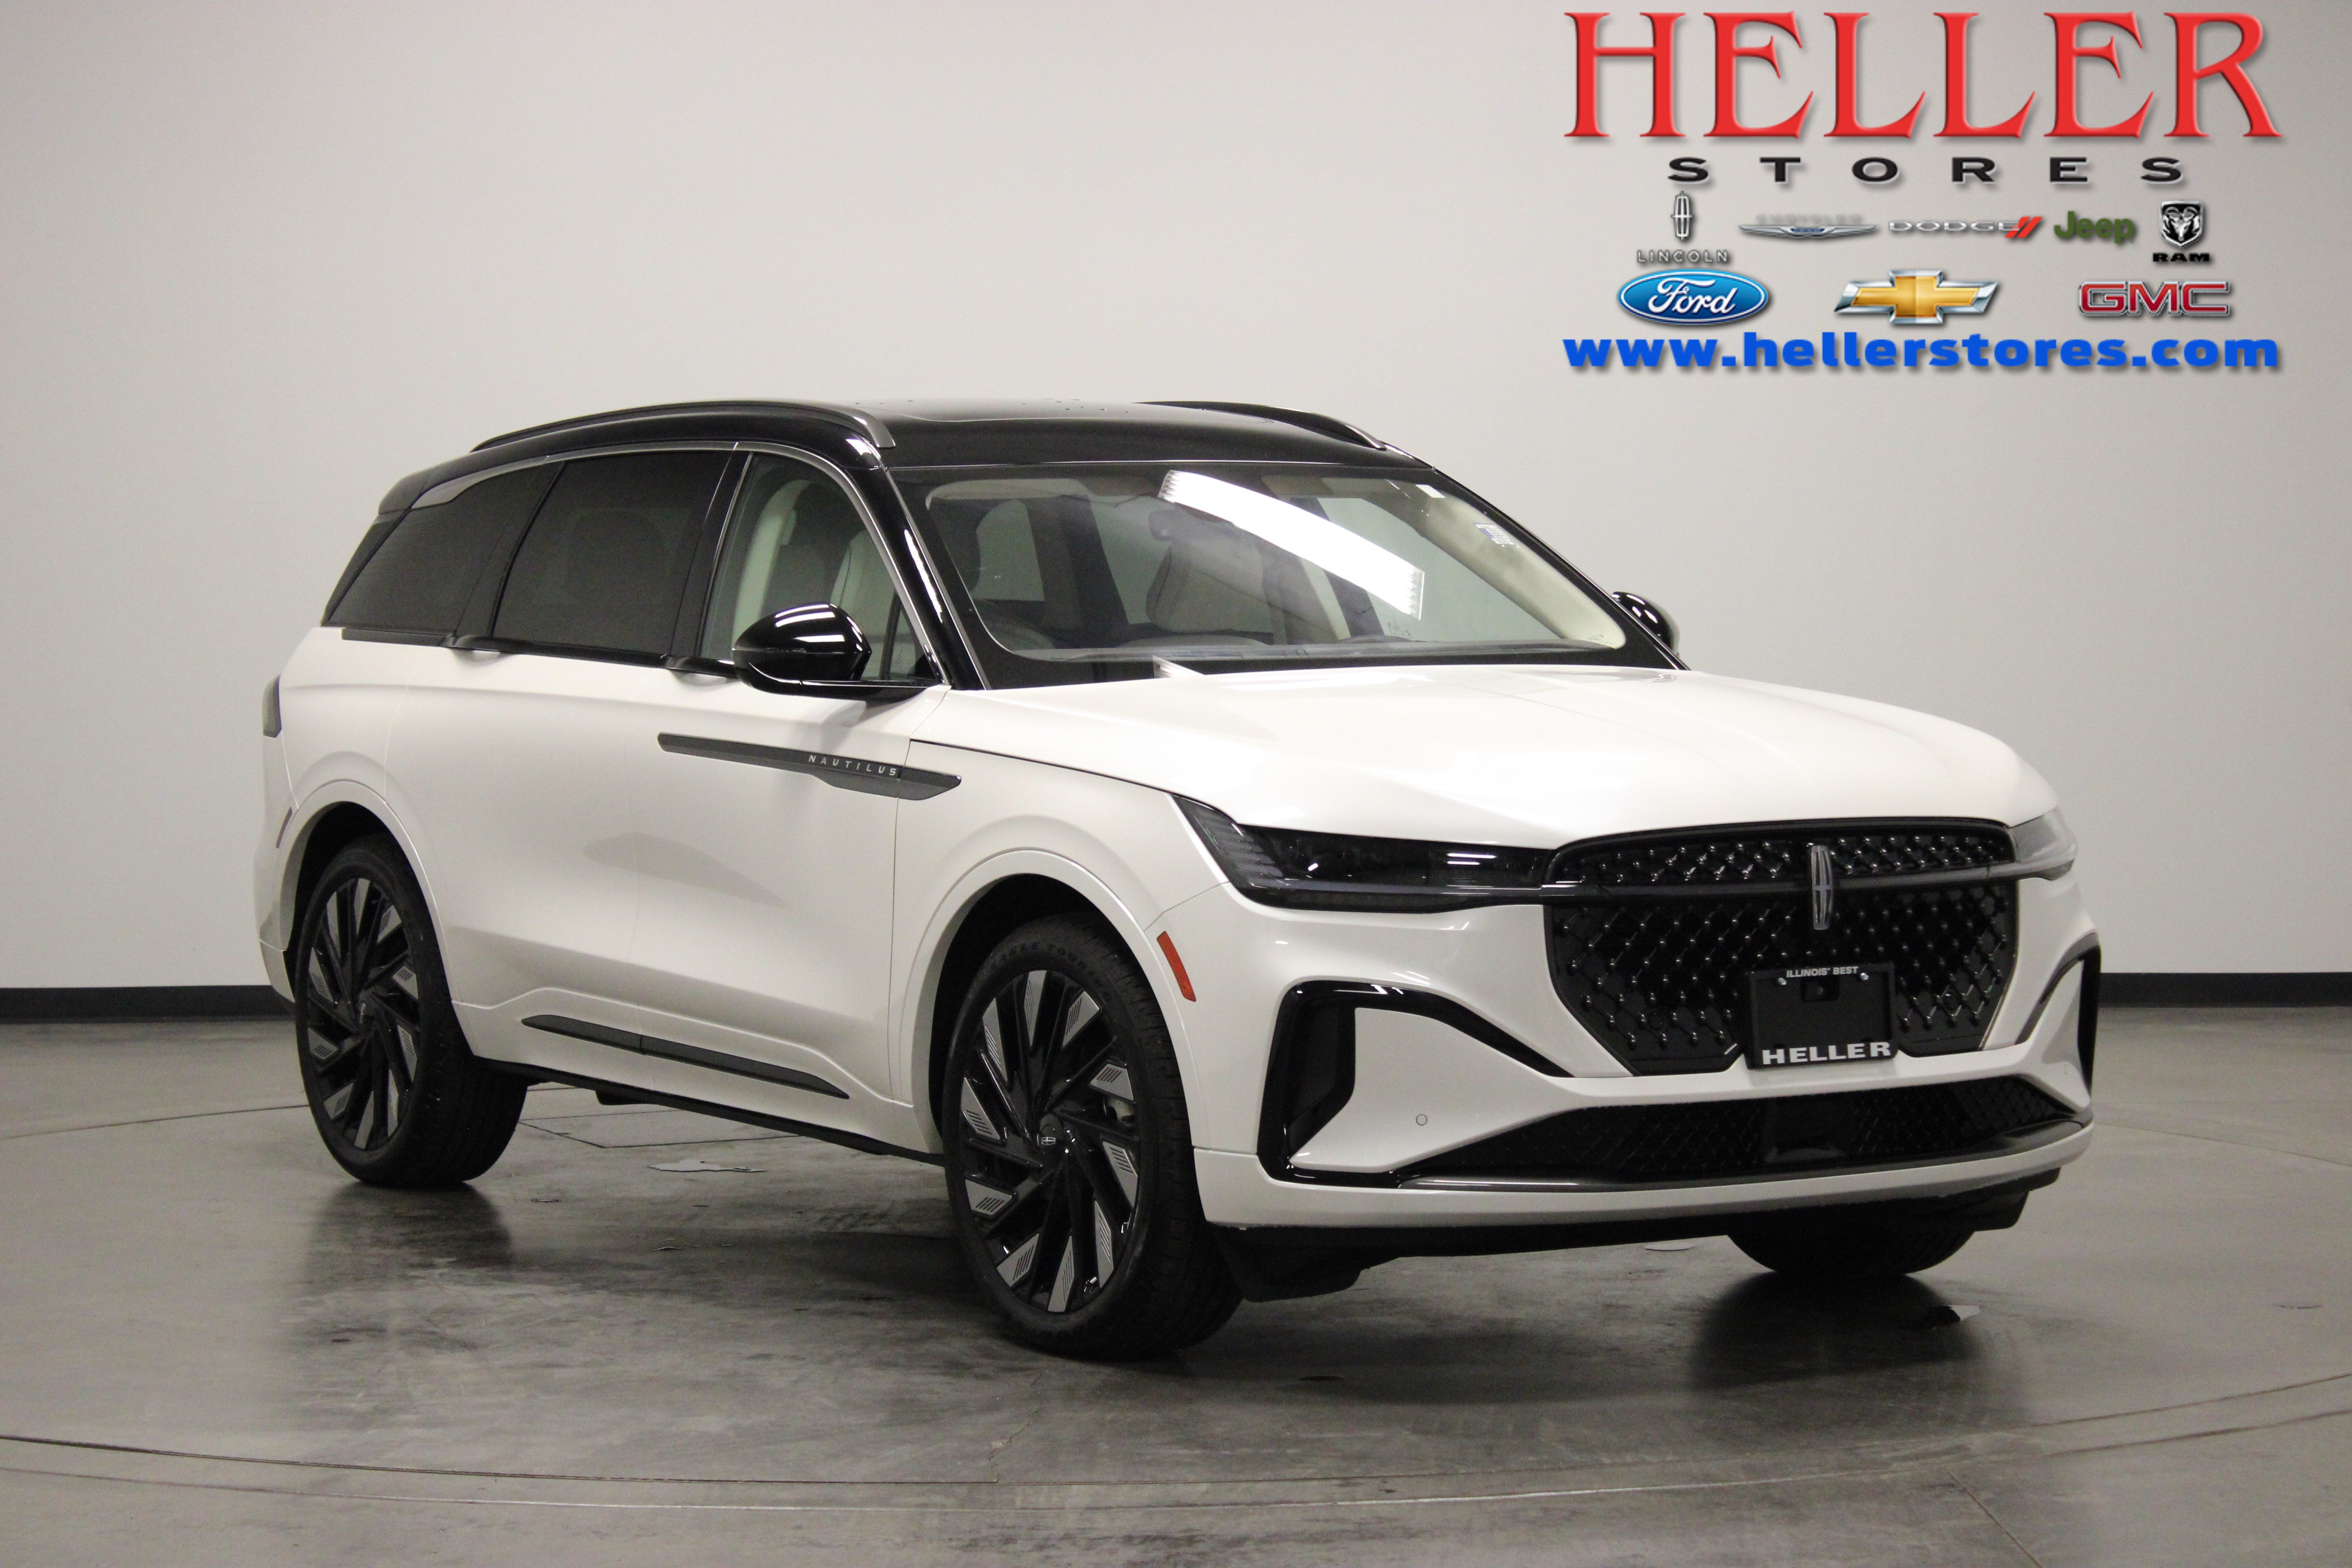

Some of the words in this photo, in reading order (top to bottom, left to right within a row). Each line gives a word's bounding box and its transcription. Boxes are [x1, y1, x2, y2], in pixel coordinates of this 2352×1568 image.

[808, 755, 896, 776] NAUTILUS
[1832, 966, 1859, 975] BEST
[1762, 1041, 1891, 1065] HELLER
